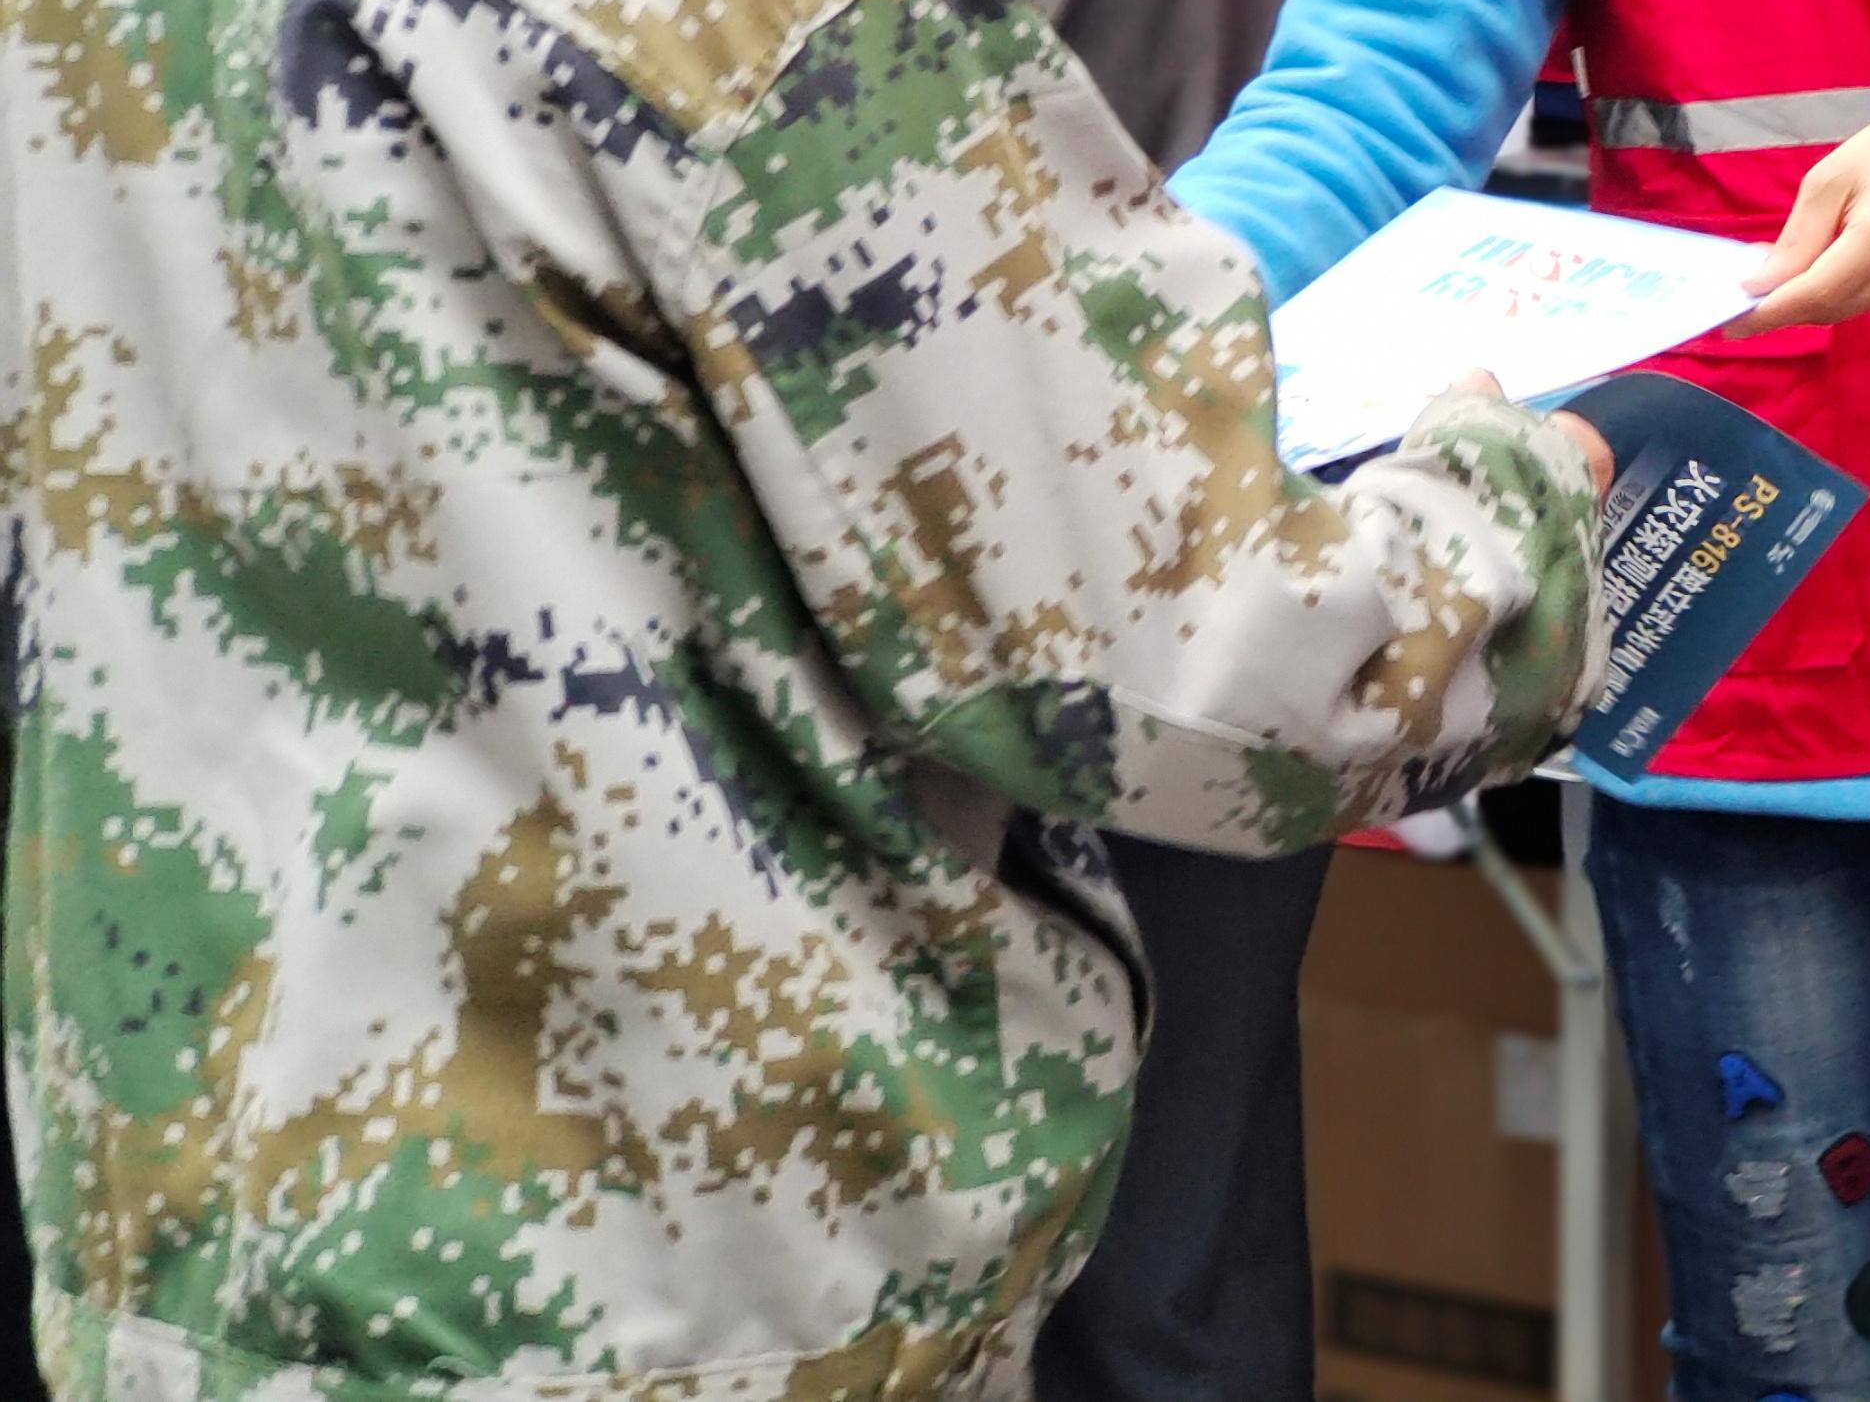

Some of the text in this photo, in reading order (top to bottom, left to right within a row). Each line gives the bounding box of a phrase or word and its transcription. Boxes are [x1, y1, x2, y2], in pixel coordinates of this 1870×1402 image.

[1602, 460, 1721, 634] 火灾探测报
